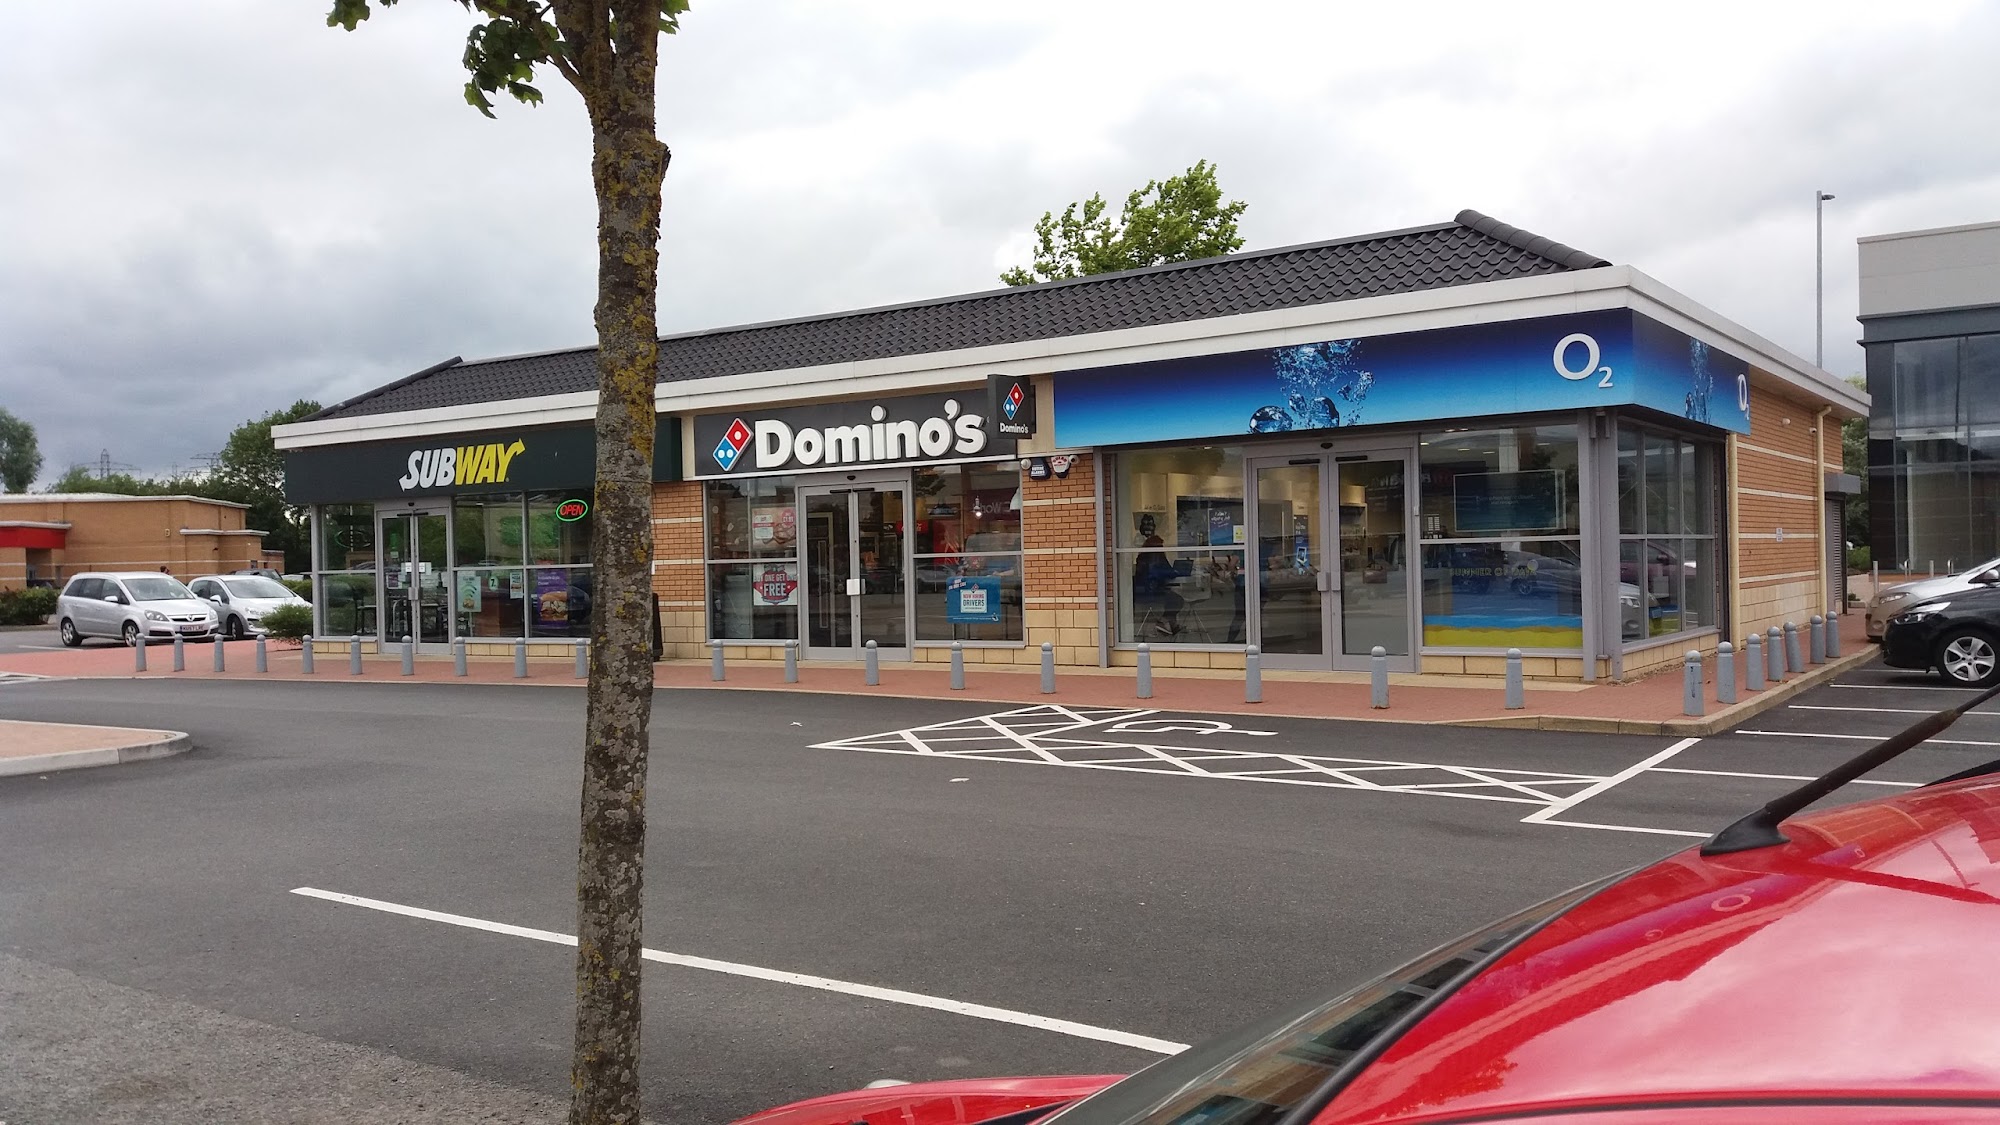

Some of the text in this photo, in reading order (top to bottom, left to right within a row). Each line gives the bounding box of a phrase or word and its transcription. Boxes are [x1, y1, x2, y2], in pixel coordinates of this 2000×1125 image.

[755, 399, 987, 468] Domino's
[999, 422, 1029, 434] Domino's
[399, 438, 525, 492] SUBWAY
[560, 504, 584, 516] OPEN
[765, 574, 775, 582] ONE
[776, 573, 786, 581] GET
[763, 583, 787, 597] FREE
[963, 599, 985, 607] DRIVERS
